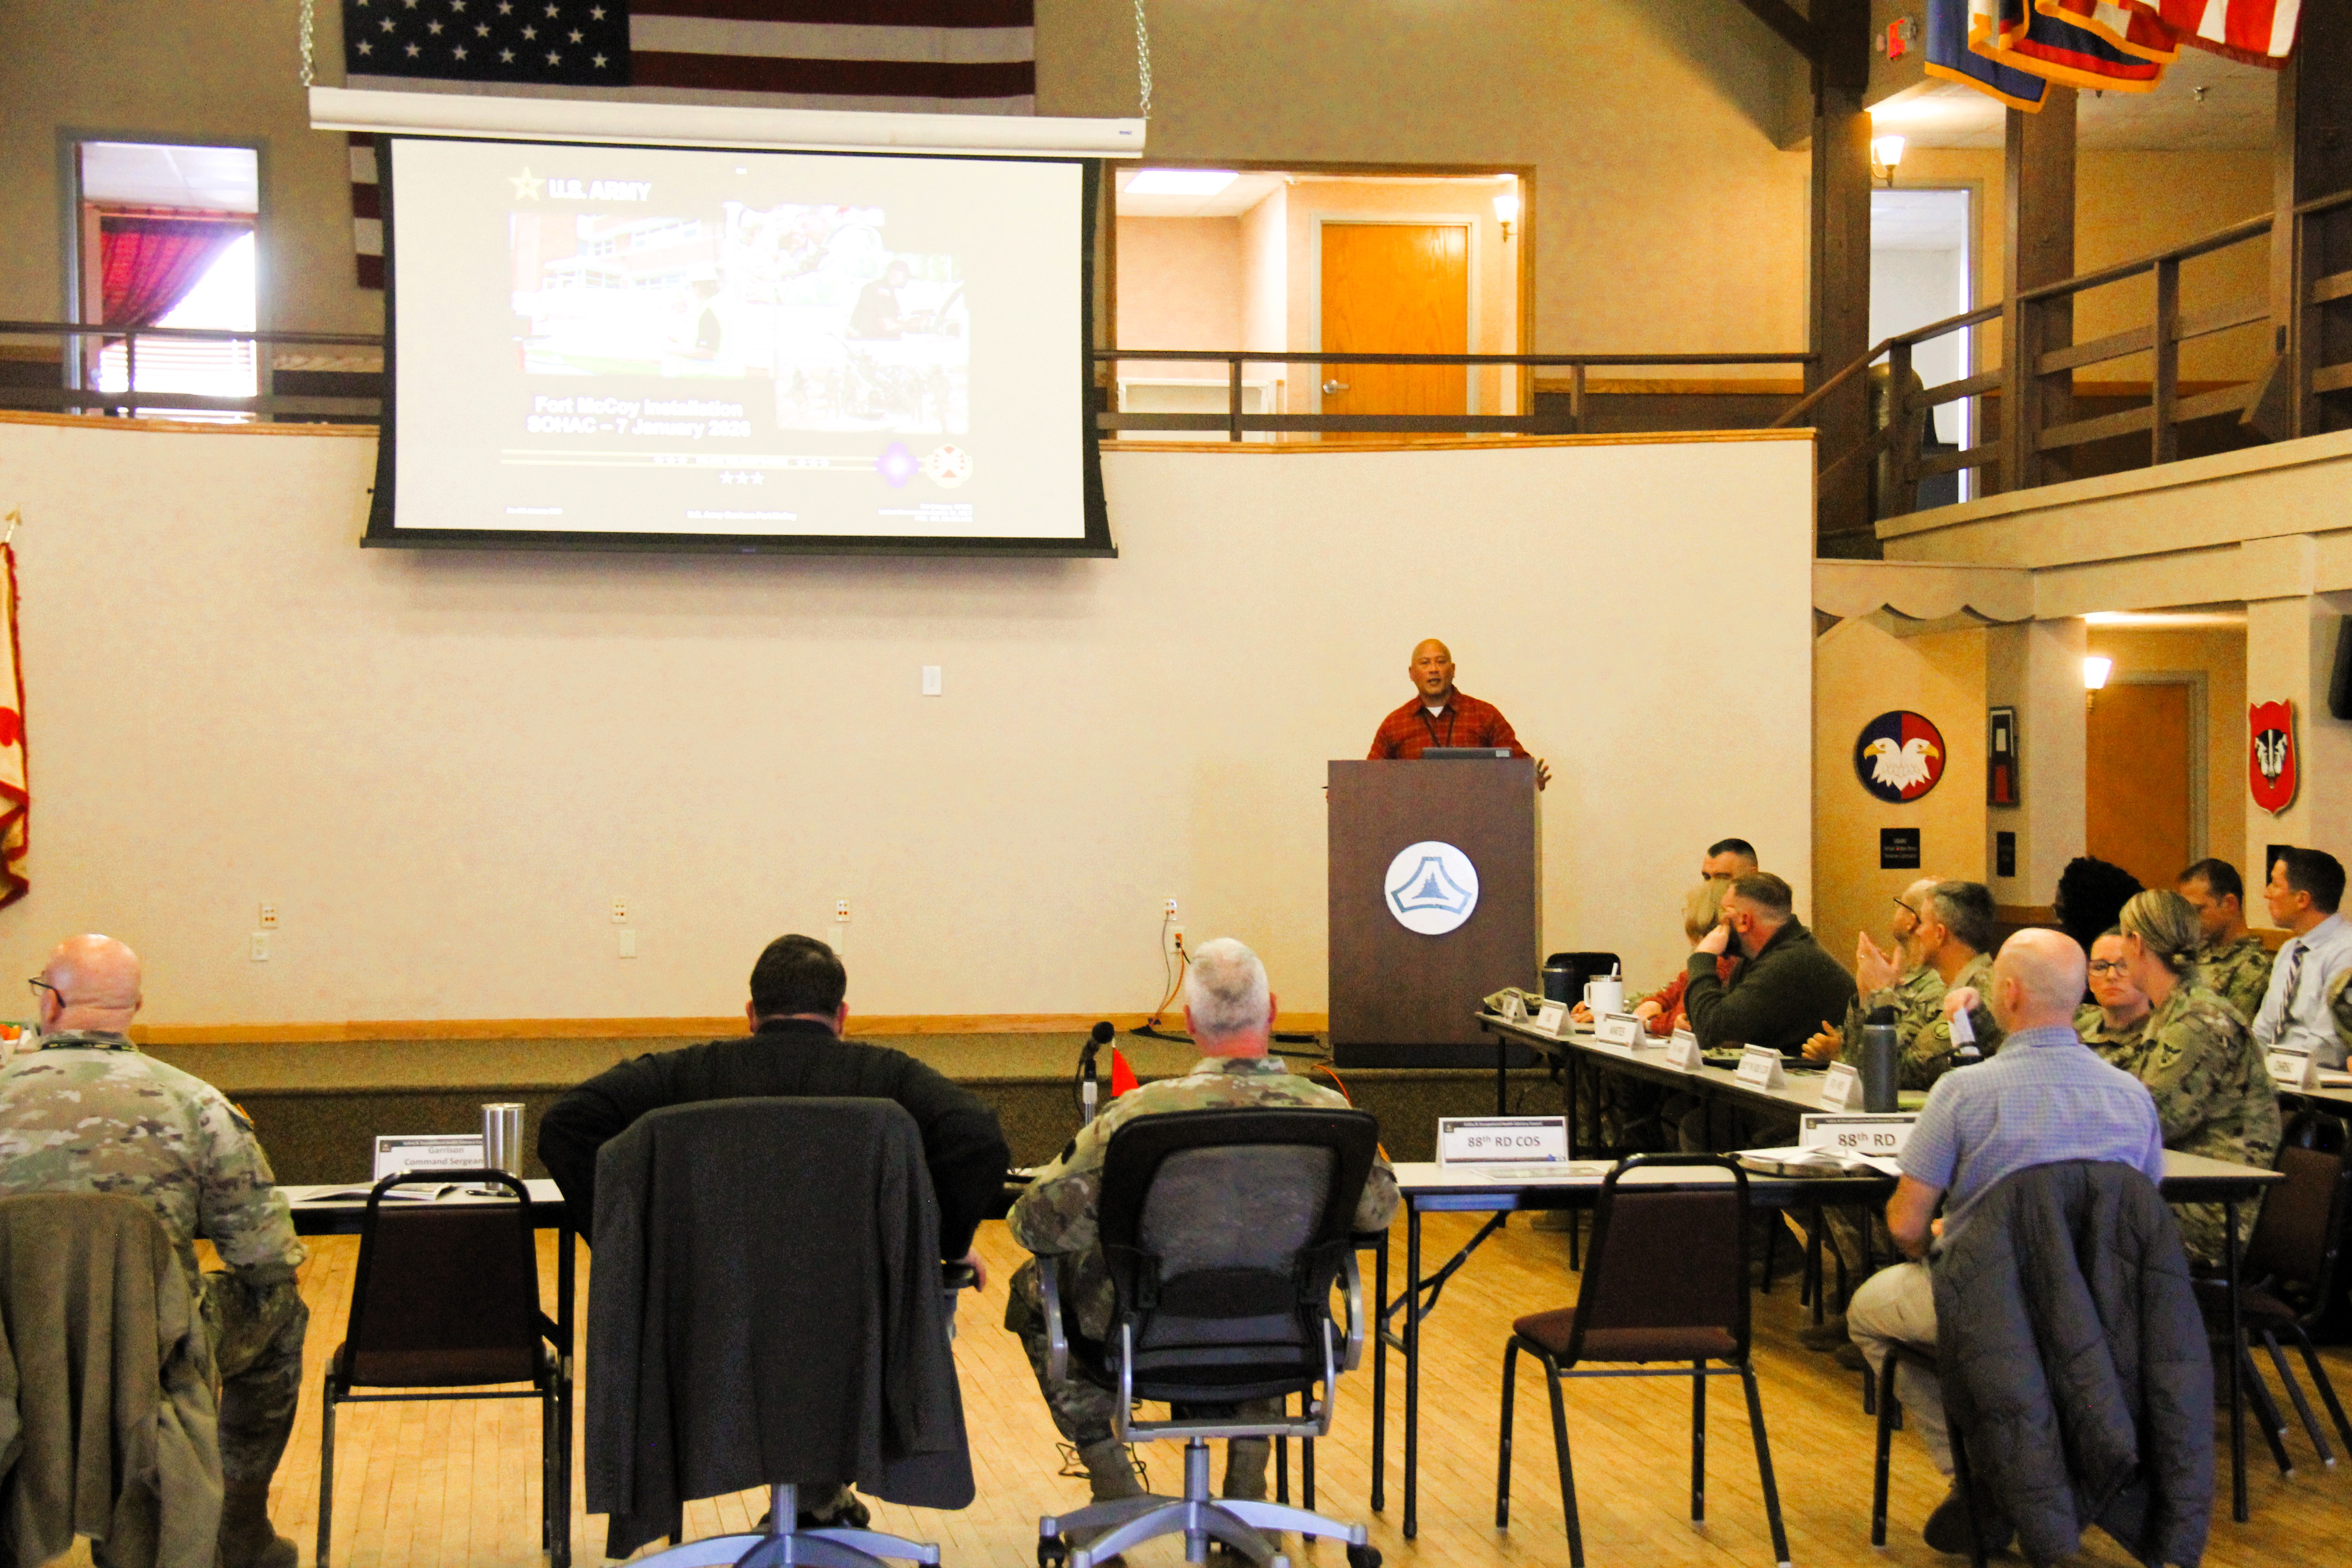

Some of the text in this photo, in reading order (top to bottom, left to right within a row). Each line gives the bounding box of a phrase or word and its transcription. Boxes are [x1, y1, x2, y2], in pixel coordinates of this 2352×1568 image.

[548, 178, 652, 201] U.S. ARMY
[533, 395, 743, 417] Fort McCoy Installation
[526, 415, 596, 432] SOHAC
[615, 417, 628, 434] 7
[630, 418, 705, 439] January
[1468, 1136, 1540, 1147] 88th RD COS
[1838, 1132, 1896, 1147] 88th RD
